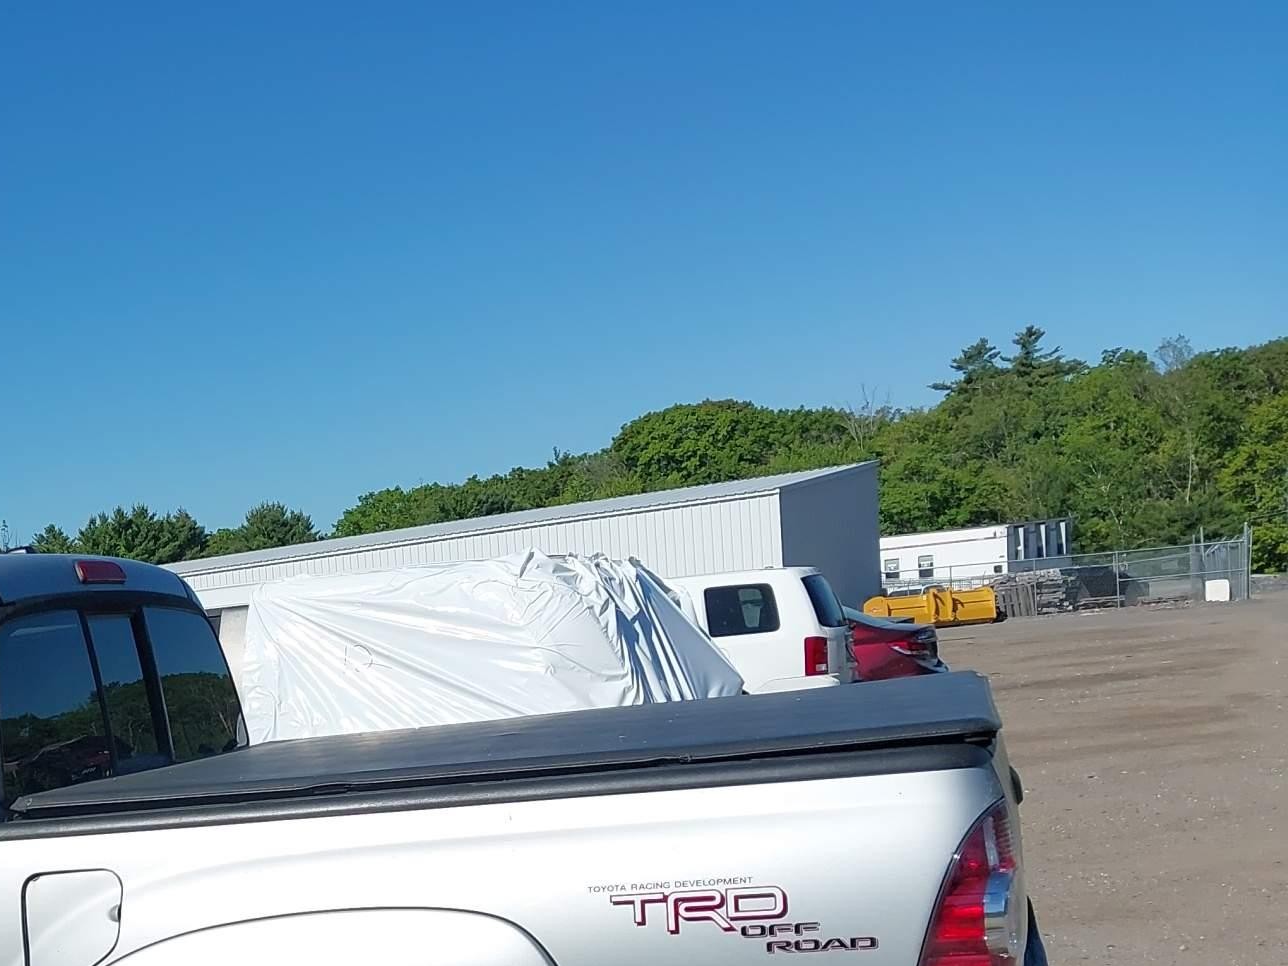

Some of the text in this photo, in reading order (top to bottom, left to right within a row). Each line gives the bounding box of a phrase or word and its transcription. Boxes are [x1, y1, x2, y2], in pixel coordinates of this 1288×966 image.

[587, 876, 753, 894] TOYOTA RACING DEVELOPMENT
[609, 885, 788, 935] TRD
[740, 921, 821, 939] OFF
[766, 936, 879, 954] ROAD
